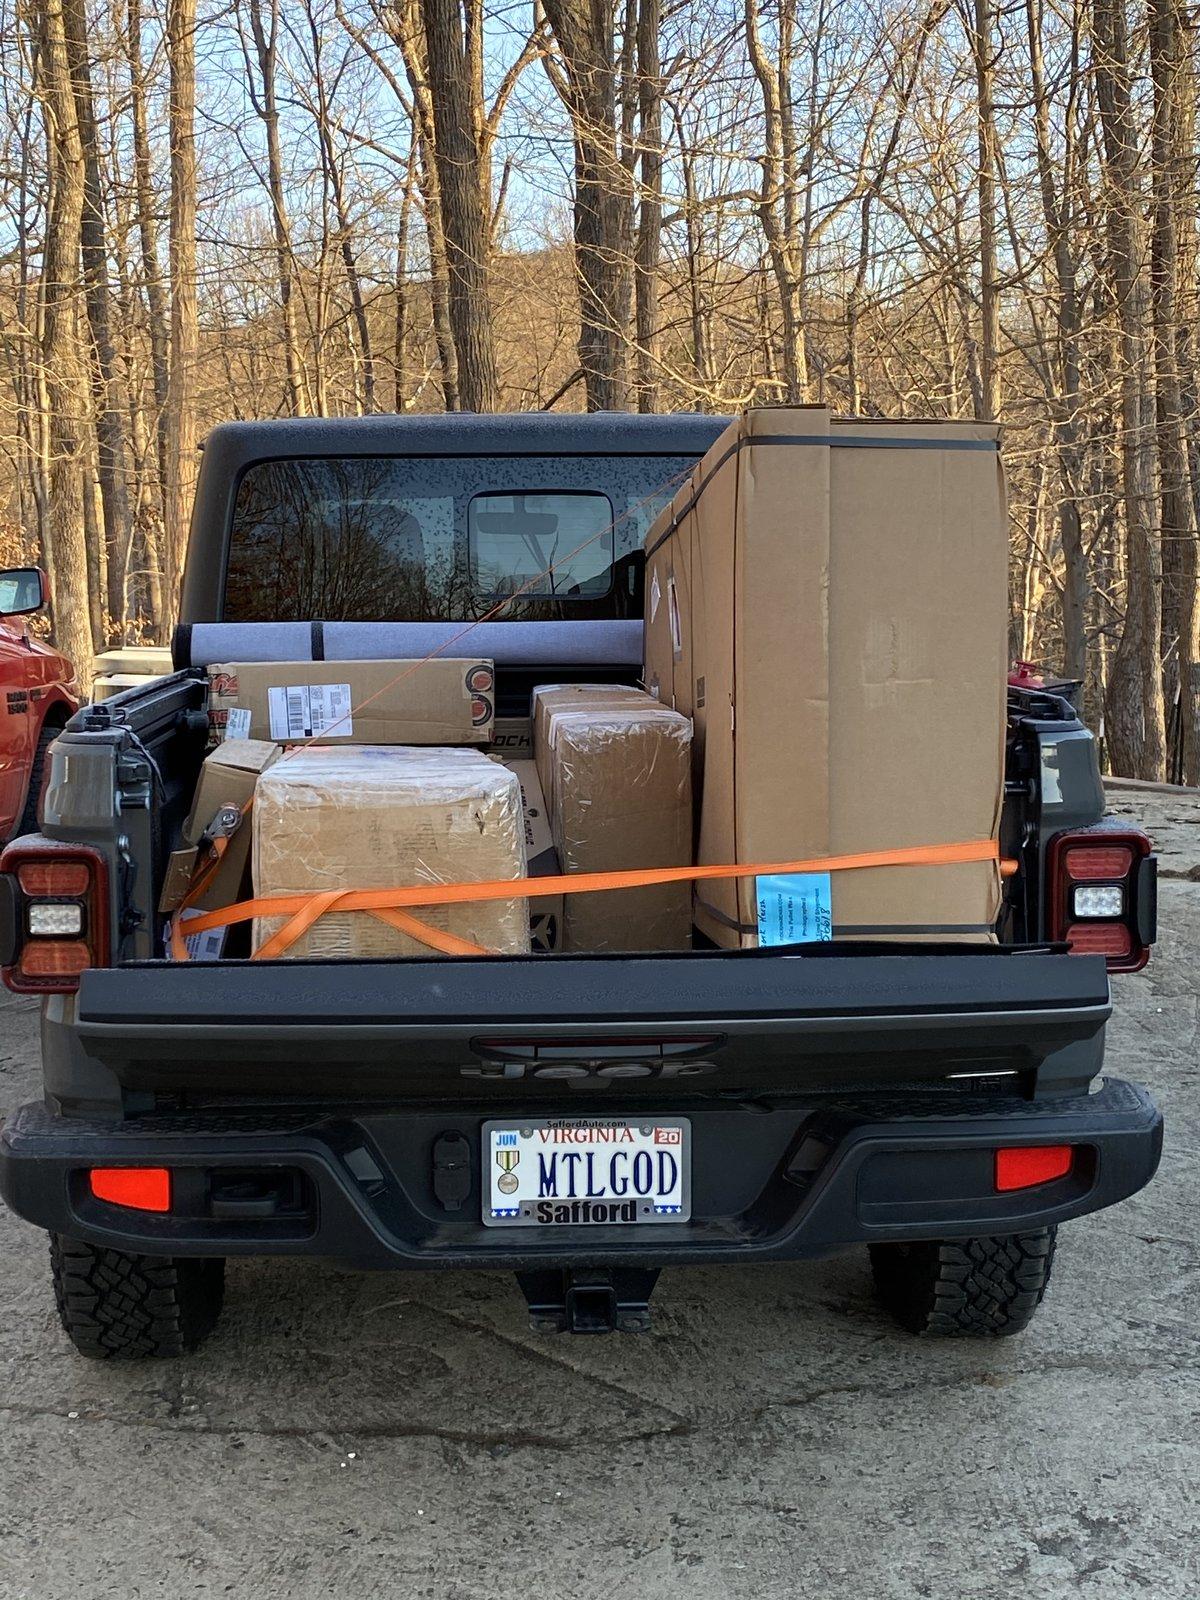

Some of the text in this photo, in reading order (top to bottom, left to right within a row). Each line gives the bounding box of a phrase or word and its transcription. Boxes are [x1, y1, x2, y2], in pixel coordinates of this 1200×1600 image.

[547, 1120, 626, 1129] SaffordAuto.com
[496, 1134, 517, 1146] JUN
[538, 1127, 635, 1144] VIRGINIA
[658, 1132, 679, 1143] 20
[538, 1150, 678, 1198] MTLGOD
[537, 1200, 637, 1224] Safford
